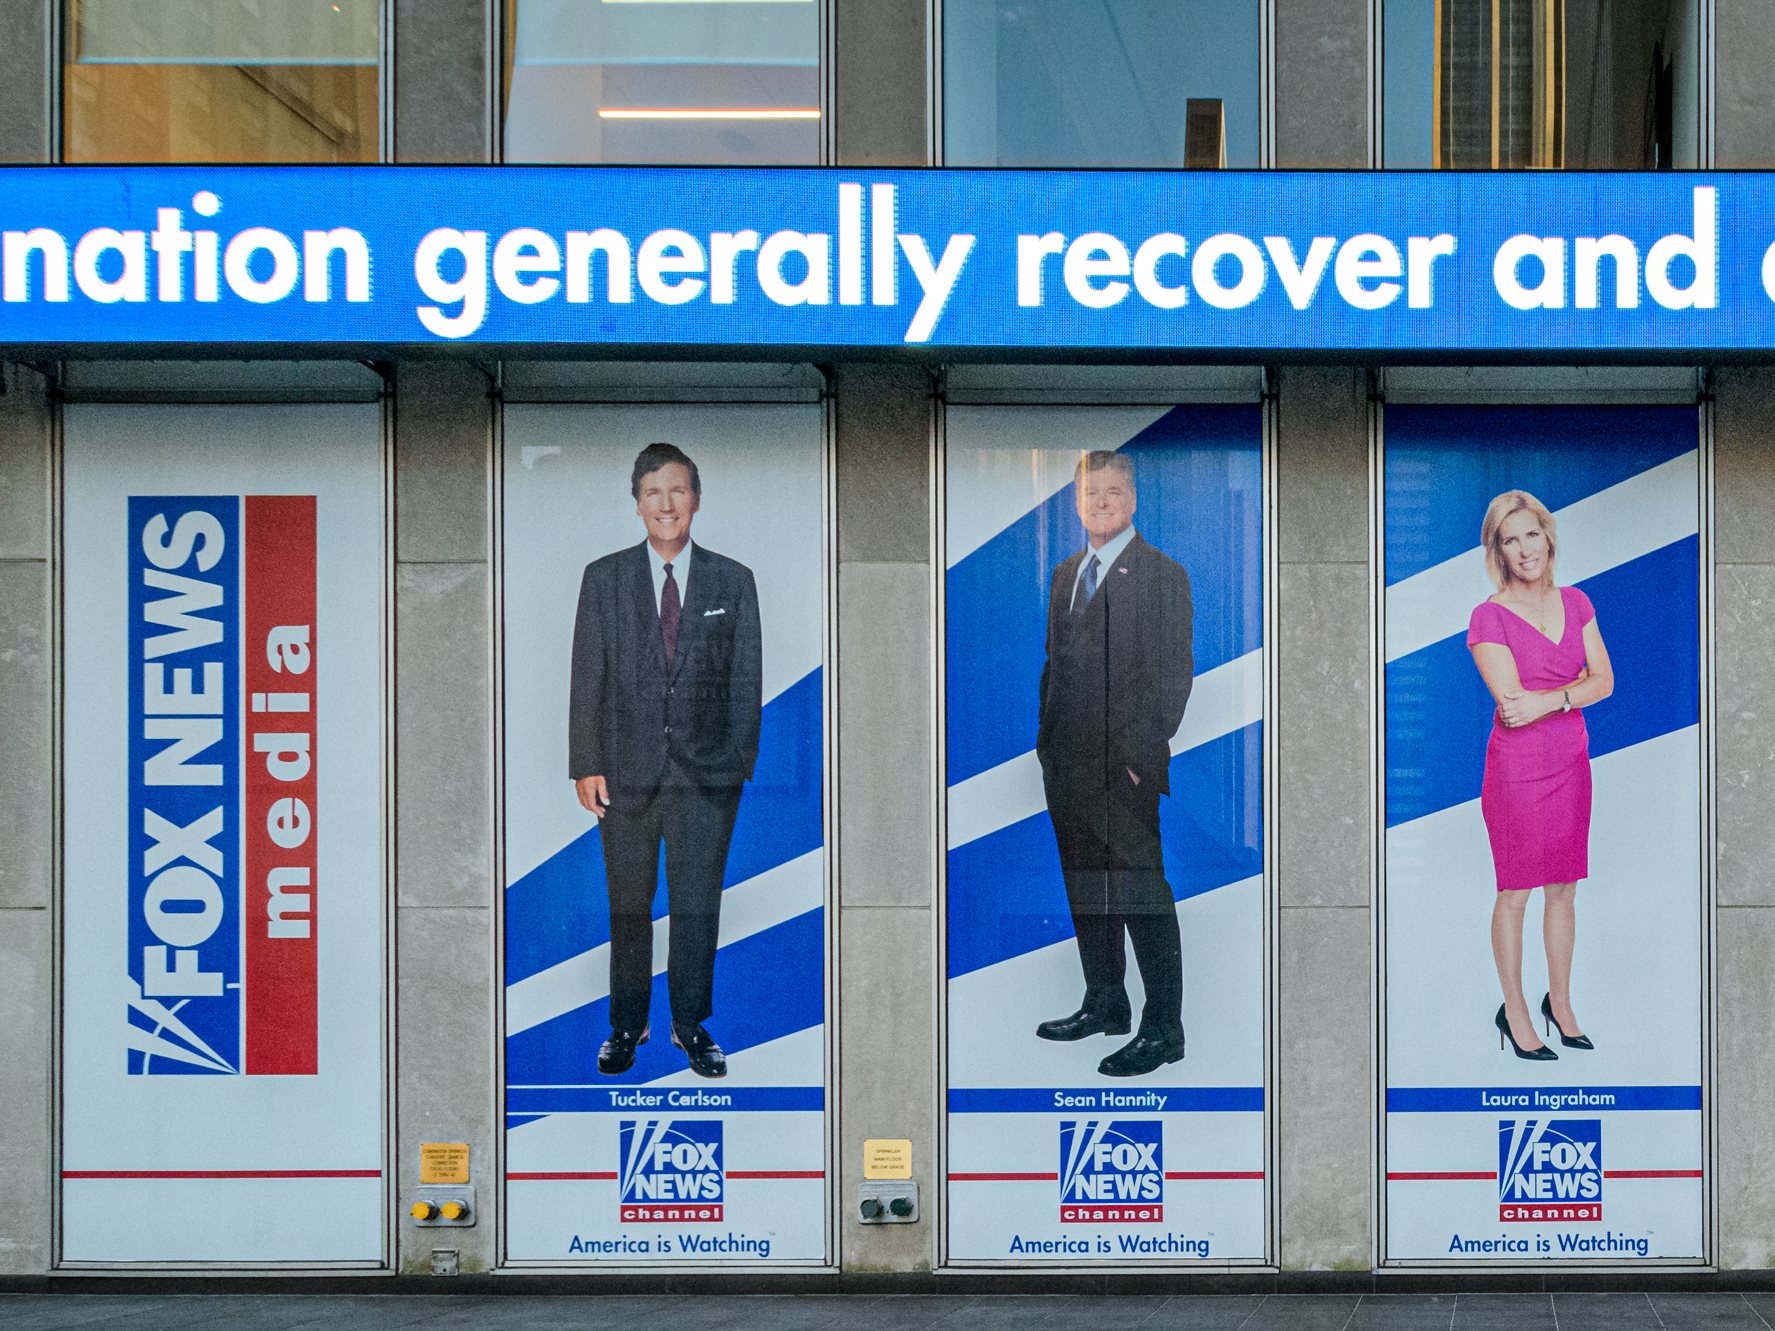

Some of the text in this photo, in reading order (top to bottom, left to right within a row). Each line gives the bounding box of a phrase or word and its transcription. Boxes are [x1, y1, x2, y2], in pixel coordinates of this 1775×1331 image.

[4, 192, 371, 304] nation
[415, 184, 976, 342] generally
[1018, 231, 1457, 310] recover
[1494, 187, 1719, 310] and
[143, 510, 226, 997] FOX NEWS
[252, 623, 311, 939] media
[609, 1090, 732, 1107] Tucker Carlson
[1054, 1091, 1168, 1110] Sean Hannity
[1482, 1090, 1615, 1110] Laura Ingraham
[654, 1143, 719, 1171] FOX
[1093, 1143, 1158, 1171] FOX
[1532, 1142, 1598, 1170] FOX
[634, 1173, 721, 1200] NEWS
[1074, 1173, 1160, 1200] NEWS
[1513, 1172, 1599, 1199] NEWS
[623, 1208, 720, 1220] channel
[1063, 1208, 1159, 1220] channel
[1502, 1207, 1598, 1219] channel
[569, 1232, 770, 1258] America is Watching
[1009, 1233, 1210, 1258] America is Watching
[1448, 1231, 1649, 1257] America is Watching
